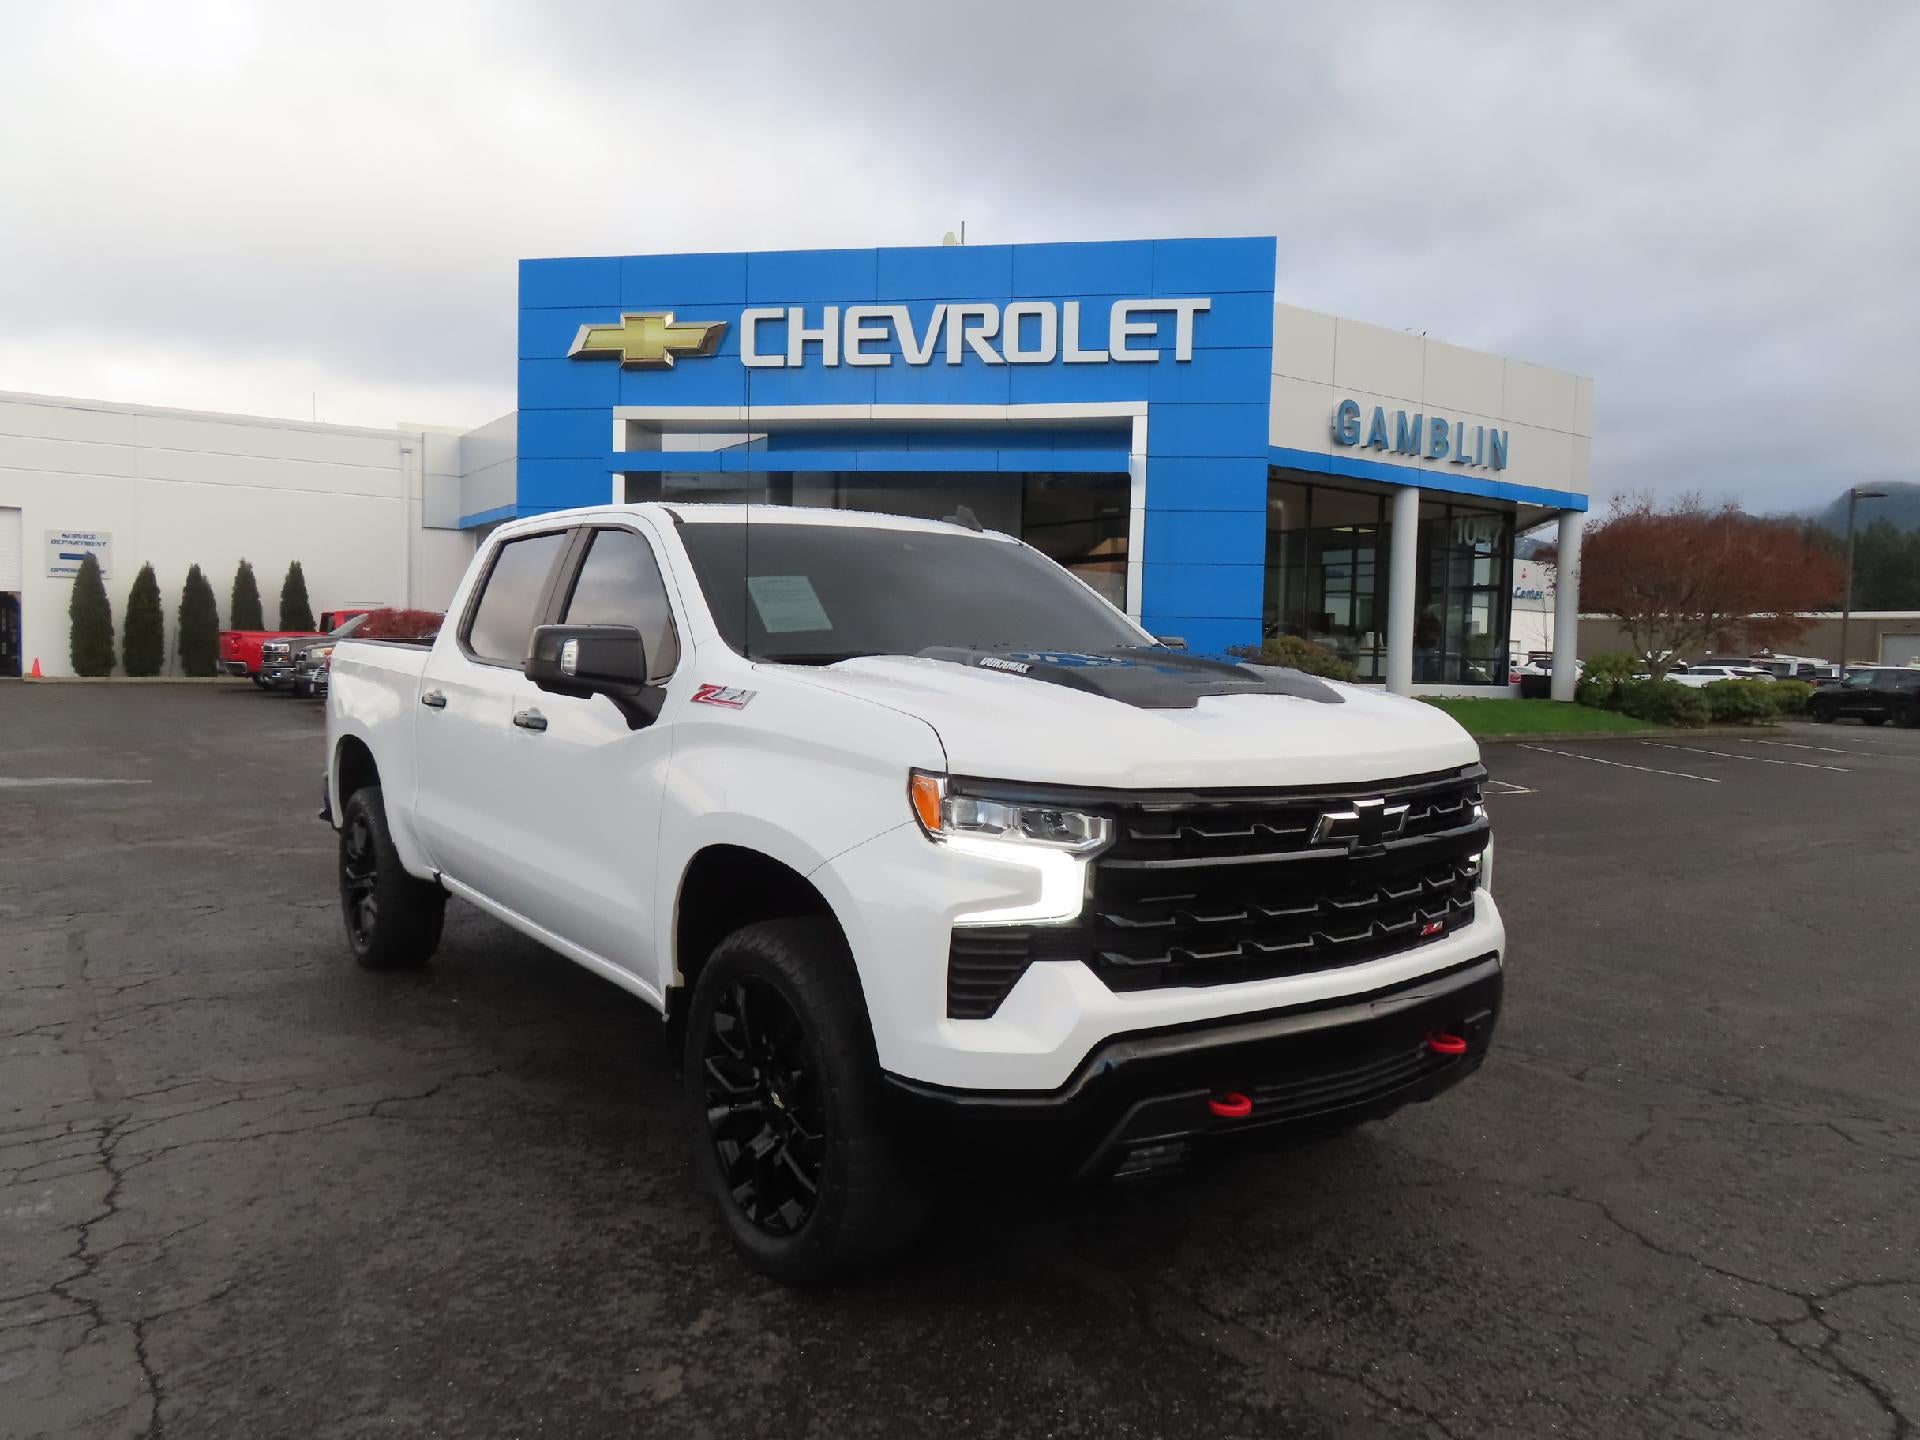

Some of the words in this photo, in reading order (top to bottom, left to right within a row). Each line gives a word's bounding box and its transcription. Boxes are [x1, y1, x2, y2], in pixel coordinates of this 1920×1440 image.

[740, 297, 1211, 367] CHEVROLET
[1332, 399, 1508, 471] GAMBLIN
[1515, 586, 1544, 600] Center
[980, 656, 1032, 674] DURAMAX
